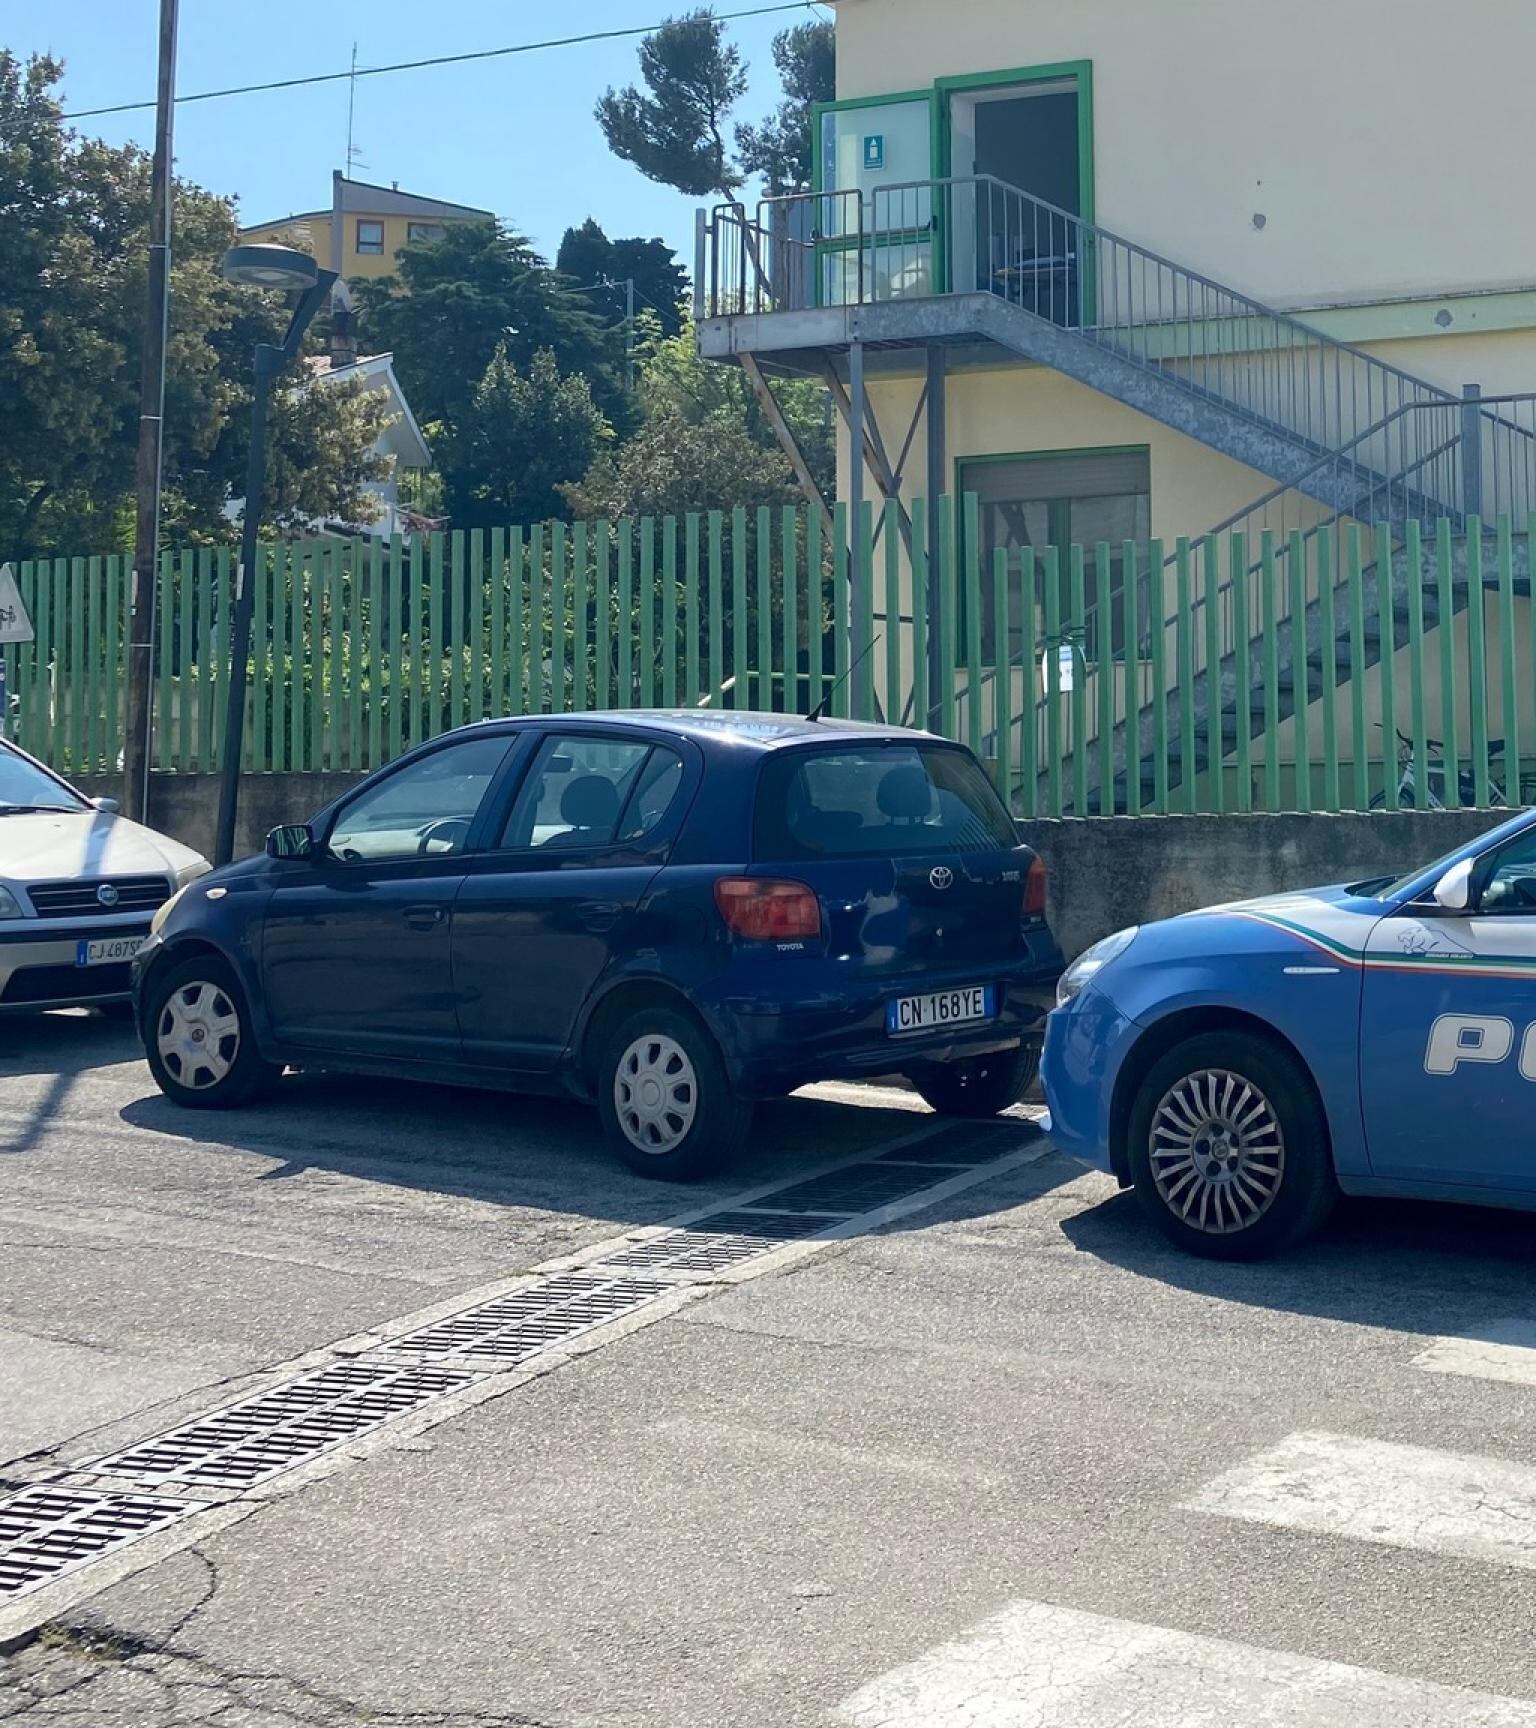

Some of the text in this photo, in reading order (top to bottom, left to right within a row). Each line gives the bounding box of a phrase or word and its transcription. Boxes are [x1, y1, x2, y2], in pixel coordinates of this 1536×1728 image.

[776, 942, 805, 951] TOYOTA
[900, 989, 983, 1027] CN 168YE
